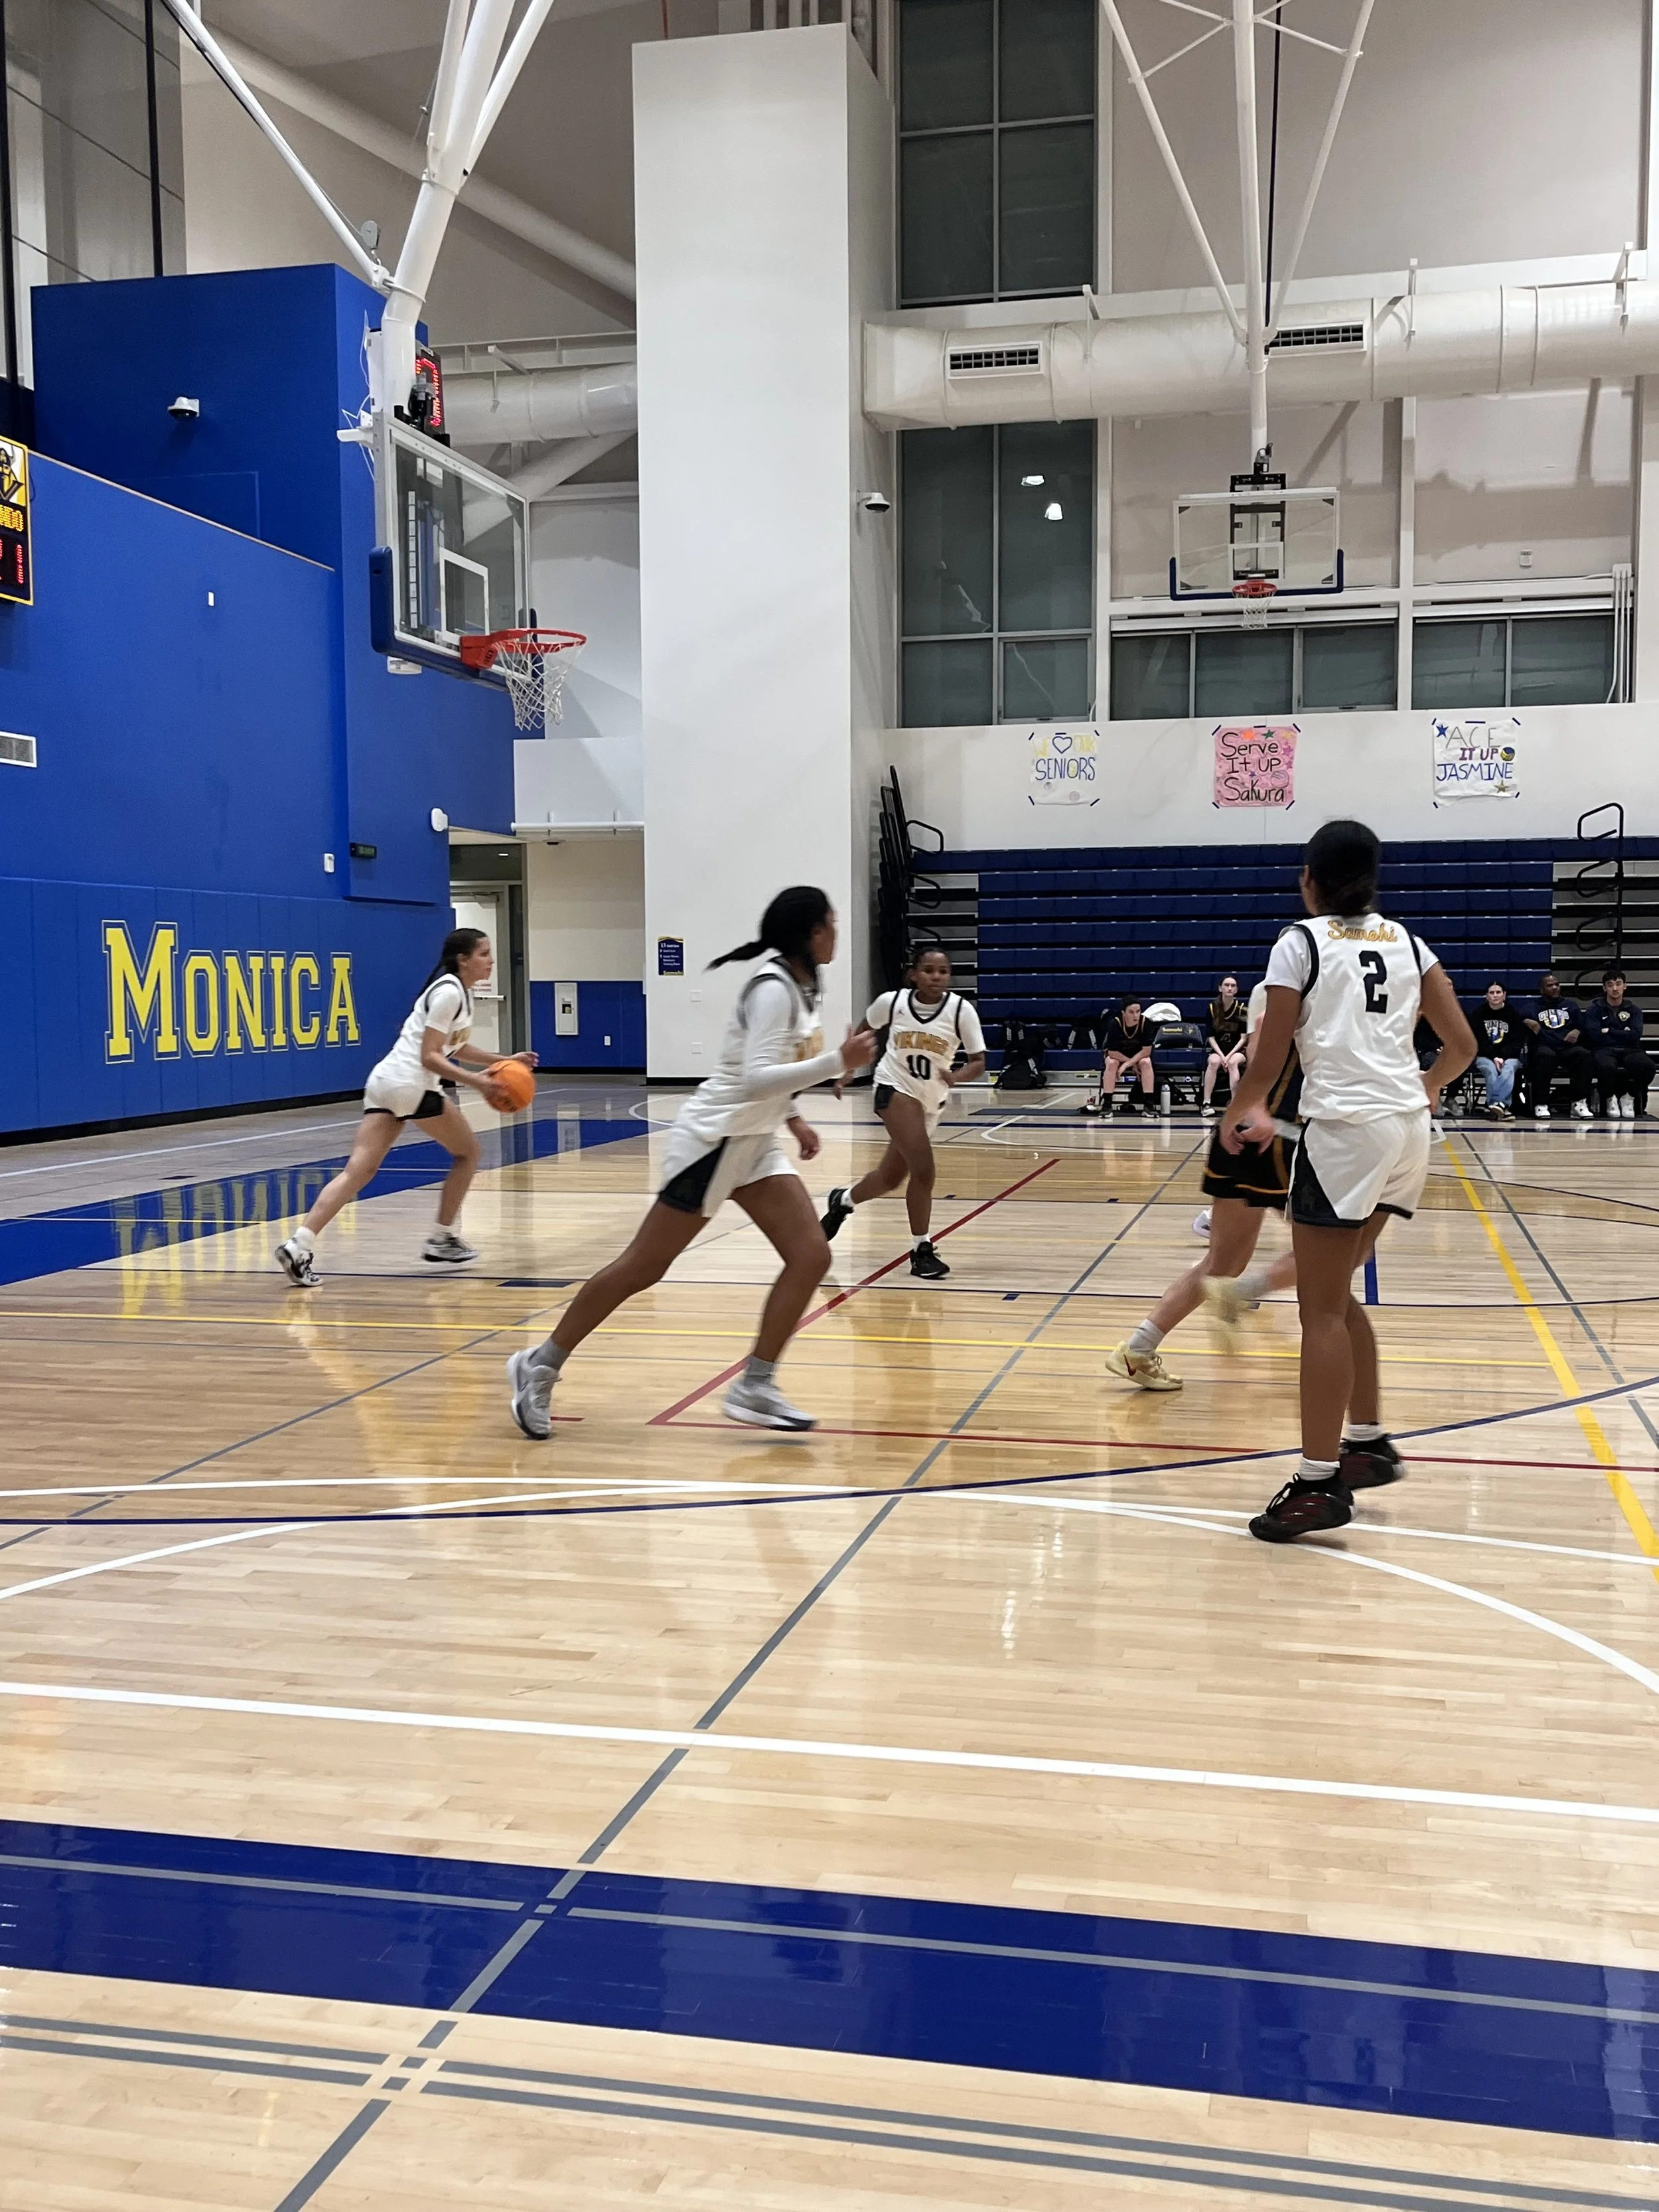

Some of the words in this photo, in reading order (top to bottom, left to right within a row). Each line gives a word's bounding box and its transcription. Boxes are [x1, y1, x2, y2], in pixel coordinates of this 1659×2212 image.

[1220, 732, 1279, 757] Serve
[1445, 726, 1501, 749] ACE
[1226, 757, 1251, 774] It
[1459, 747, 1476, 761] IT
[1480, 747, 1499, 761] UP
[1035, 757, 1096, 780] SENIORS
[1435, 763, 1514, 782] JASMINE
[1358, 950, 1388, 1013] 2
[906, 1055, 932, 1080] 10
